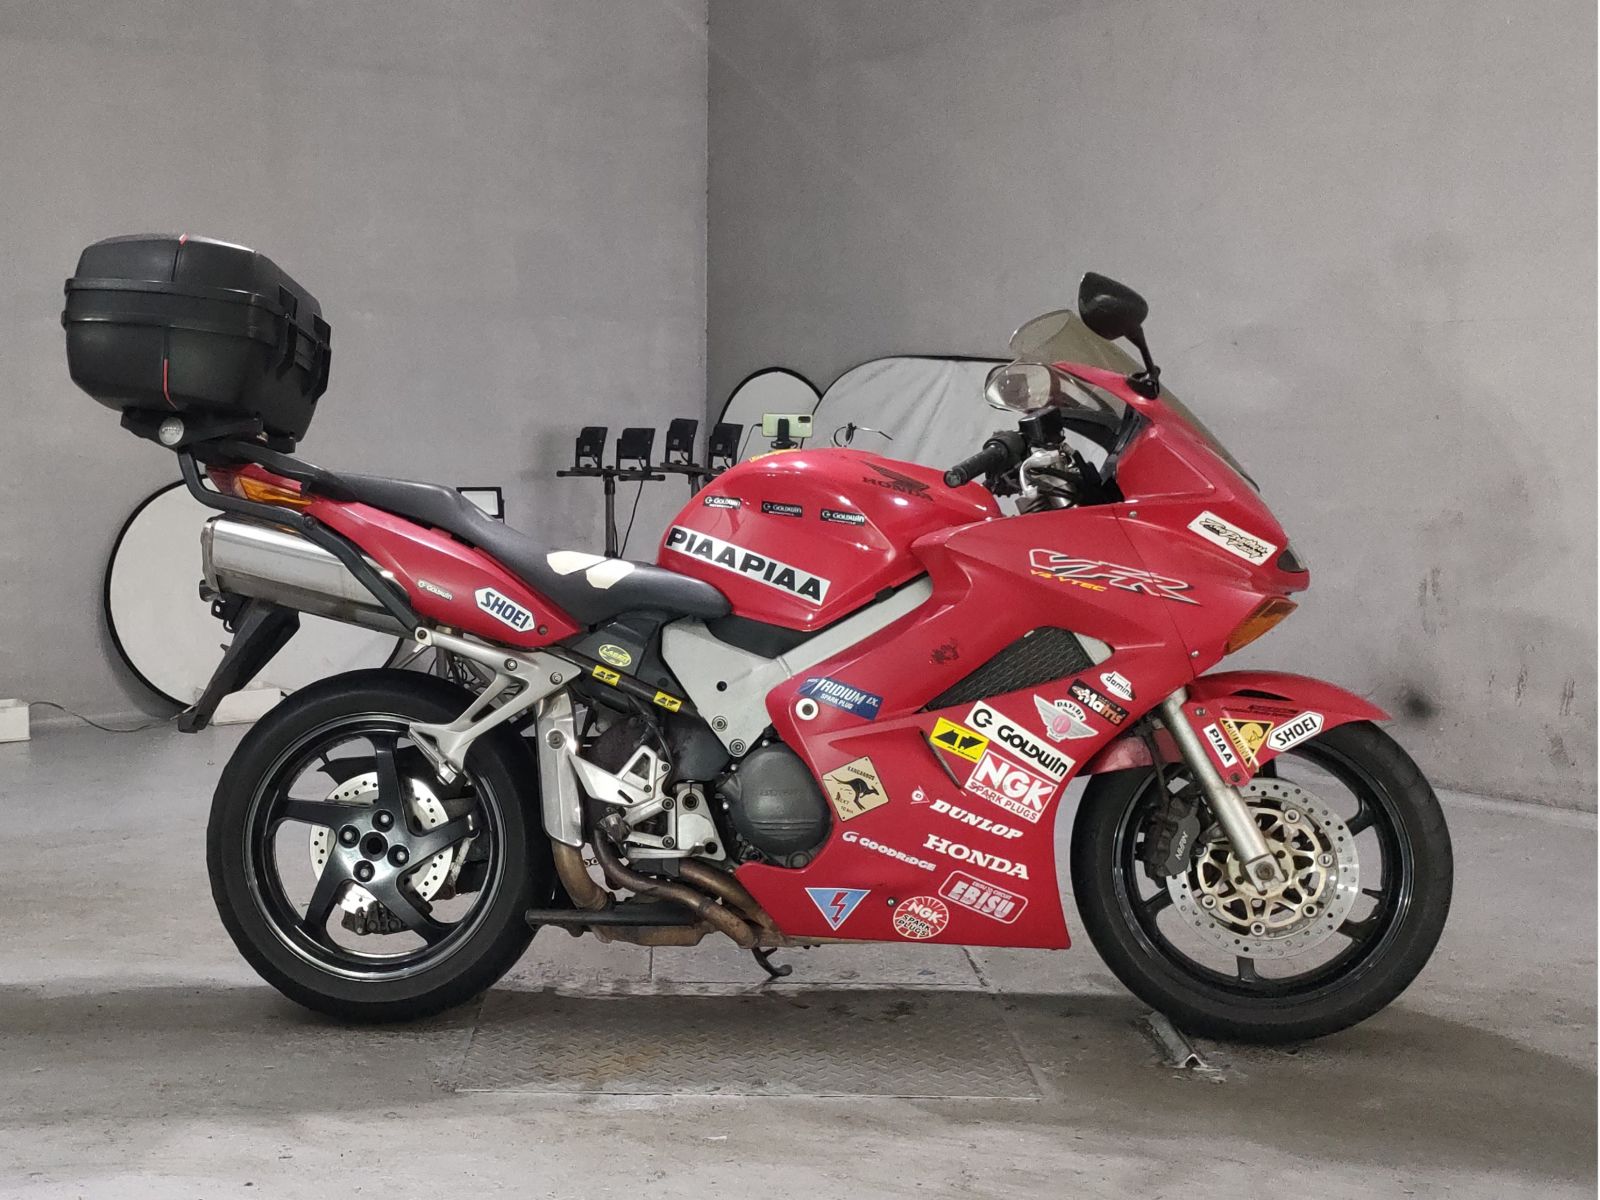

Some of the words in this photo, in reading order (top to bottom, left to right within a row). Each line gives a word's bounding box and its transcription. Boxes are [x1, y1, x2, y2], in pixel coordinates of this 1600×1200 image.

[1058, 576, 1108, 592] VTEC
[480, 591, 530, 629] SHOEI
[1208, 728, 1233, 763] PIAA
[1275, 716, 1318, 747] SHOEI
[974, 753, 1053, 813] NGK
[929, 799, 1024, 840] DUNLOP
[967, 781, 1006, 804] SPARK
[1004, 801, 1039, 822] PLUGS
[922, 833, 1030, 880] HONDA
[907, 901, 943, 924] NGK
[947, 880, 1016, 918] EBISU
[898, 919, 927, 936] PLUGS
[903, 914, 932, 931] SPARK
